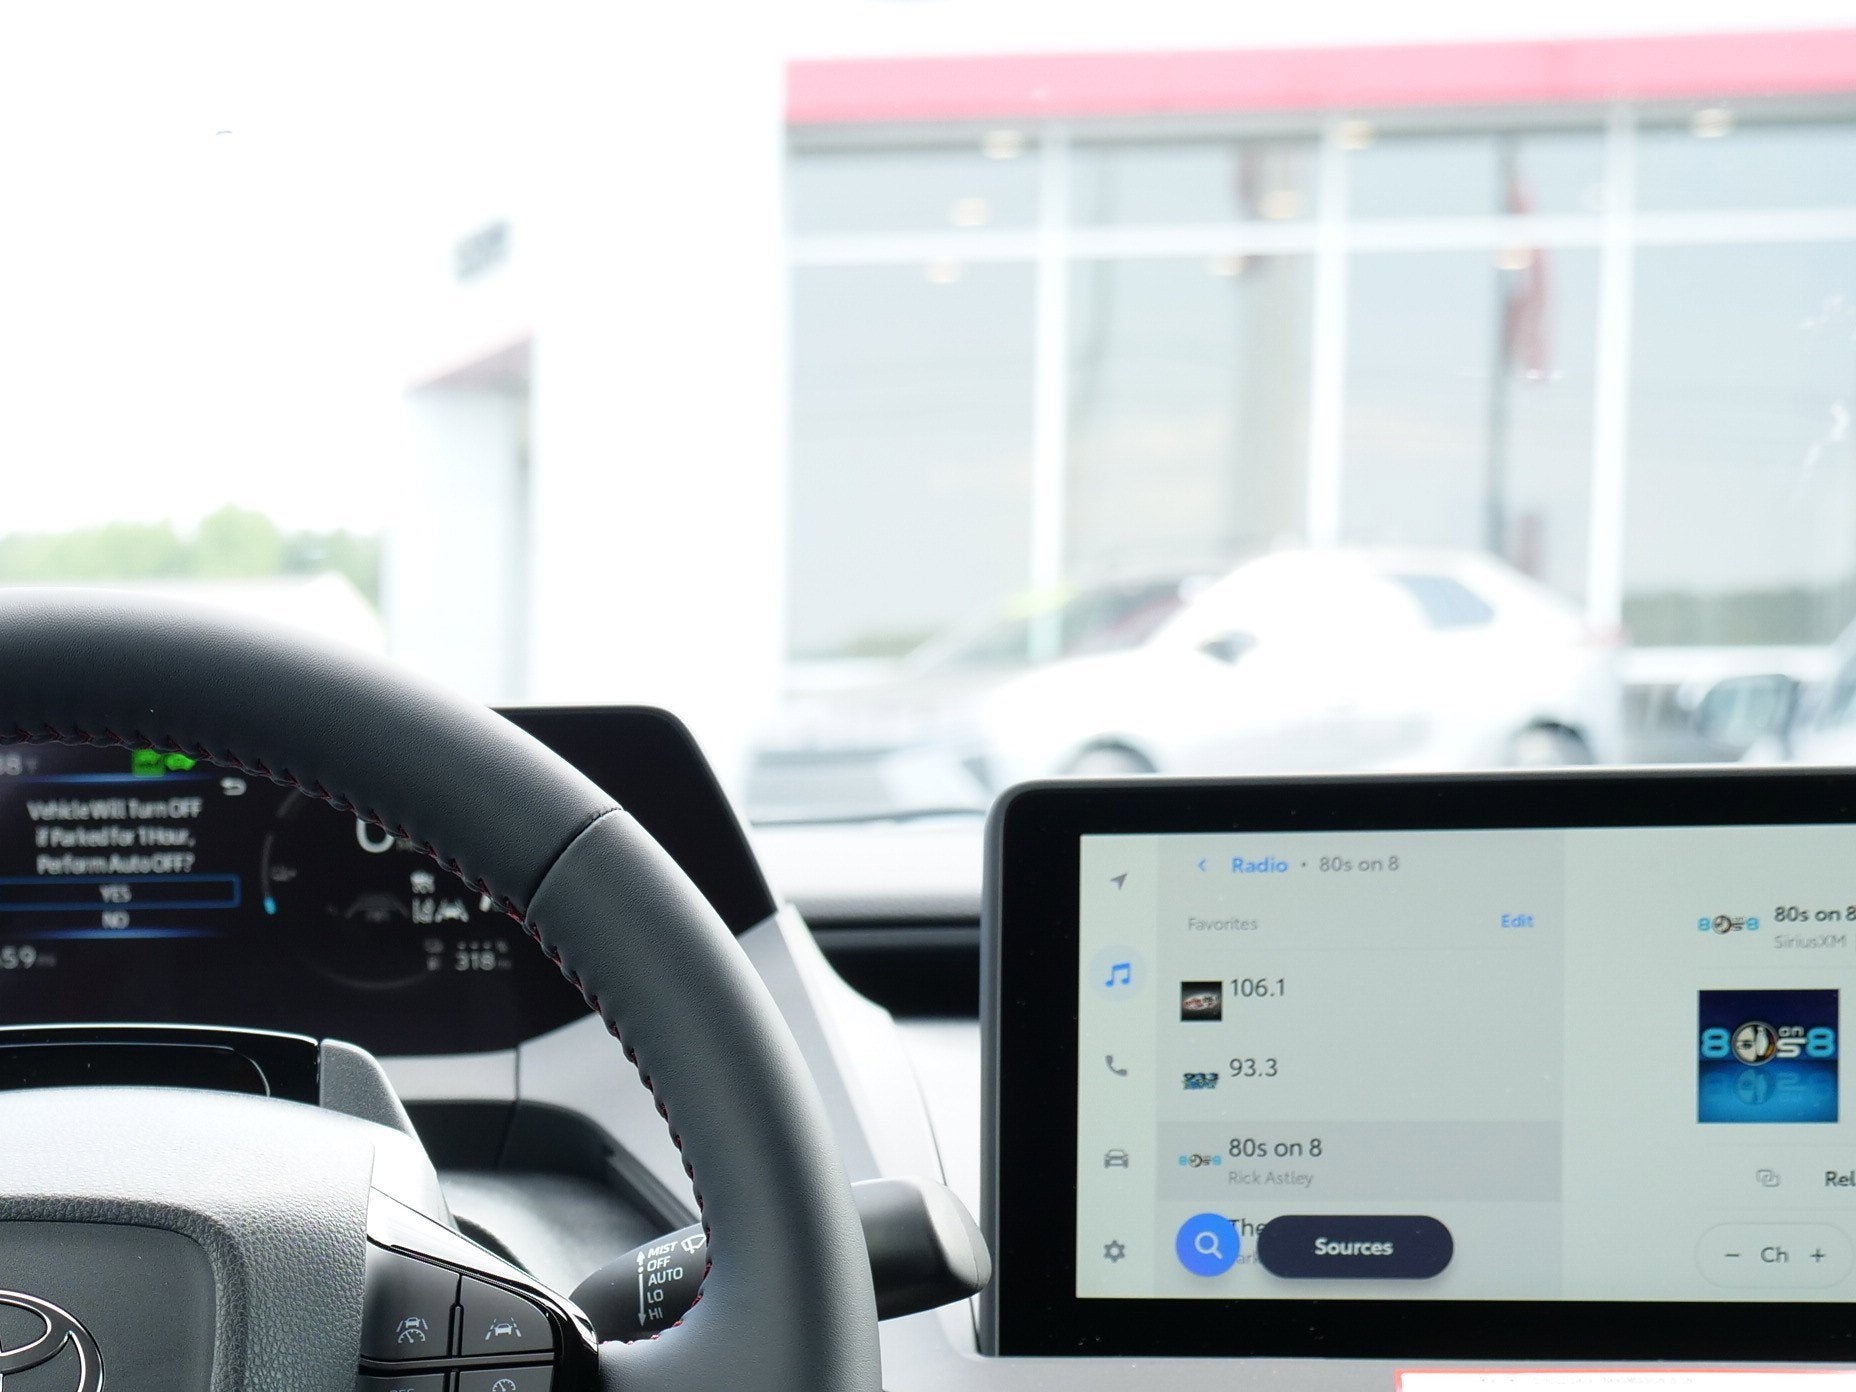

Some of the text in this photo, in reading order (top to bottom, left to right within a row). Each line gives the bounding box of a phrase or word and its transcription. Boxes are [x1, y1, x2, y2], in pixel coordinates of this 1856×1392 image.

[128, 798, 167, 819] Turn
[167, 797, 202, 818] OFF
[50, 826, 109, 847] Parked
[36, 852, 108, 875] Perform
[1231, 856, 1400, 873] Radio 80s on 8
[1501, 914, 1534, 928] Edit
[1774, 905, 1856, 922] 80s on 8
[1188, 917, 1258, 932] Favorites
[1774, 935, 1846, 949] SiriusXM
[1231, 978, 1285, 997] 106.1
[1229, 1058, 1278, 1077] 93.3
[1228, 1138, 1322, 1157] 80s on 8
[1228, 1171, 1313, 1188] Rick Astley
[648, 1241, 678, 1258] MIST
[1314, 1237, 1394, 1255] Sources
[647, 1256, 671, 1271] OFF
[1761, 1247, 1789, 1263] Ch
[648, 1267, 684, 1286] AUTO
[647, 1289, 664, 1304] LO
[648, 1307, 663, 1320] HI
